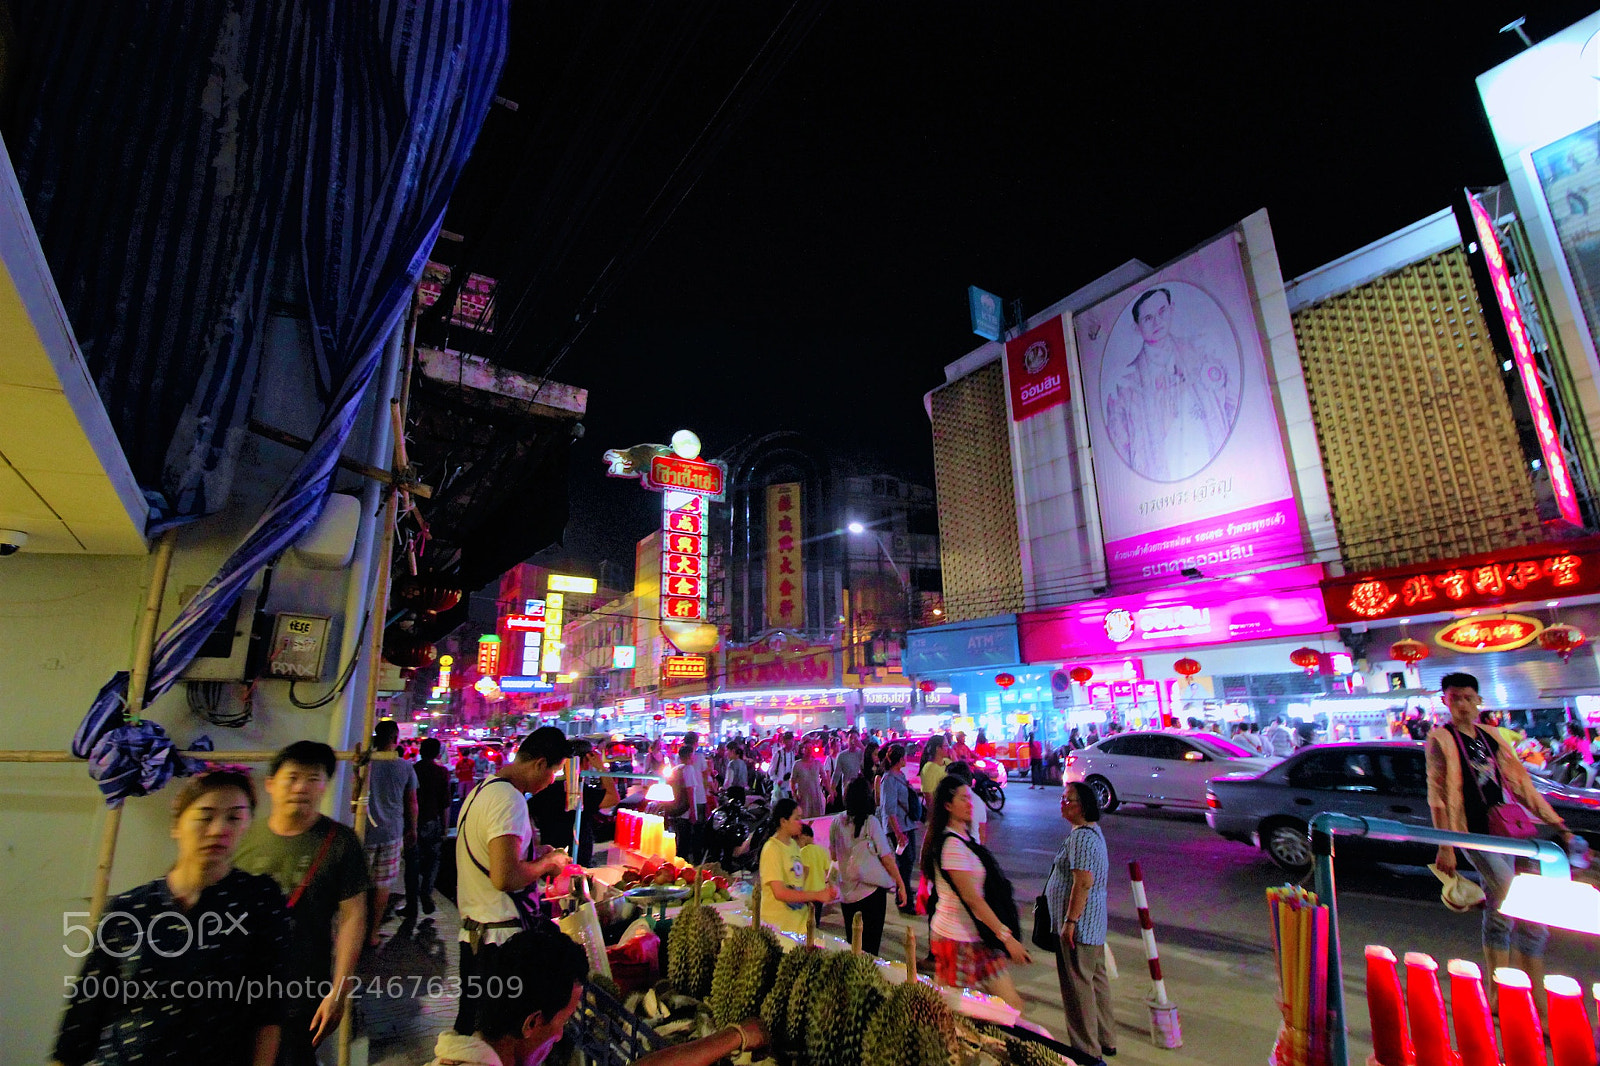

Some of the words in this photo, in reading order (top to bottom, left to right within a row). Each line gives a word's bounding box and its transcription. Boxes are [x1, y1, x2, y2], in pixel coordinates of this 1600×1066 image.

[1021, 374, 1061, 400] ออมสิน
[1142, 544, 1254, 577] ธนาคารออมสิน
[1402, 555, 1582, 606] 北京同仁堂
[968, 635, 994, 649] ATM
